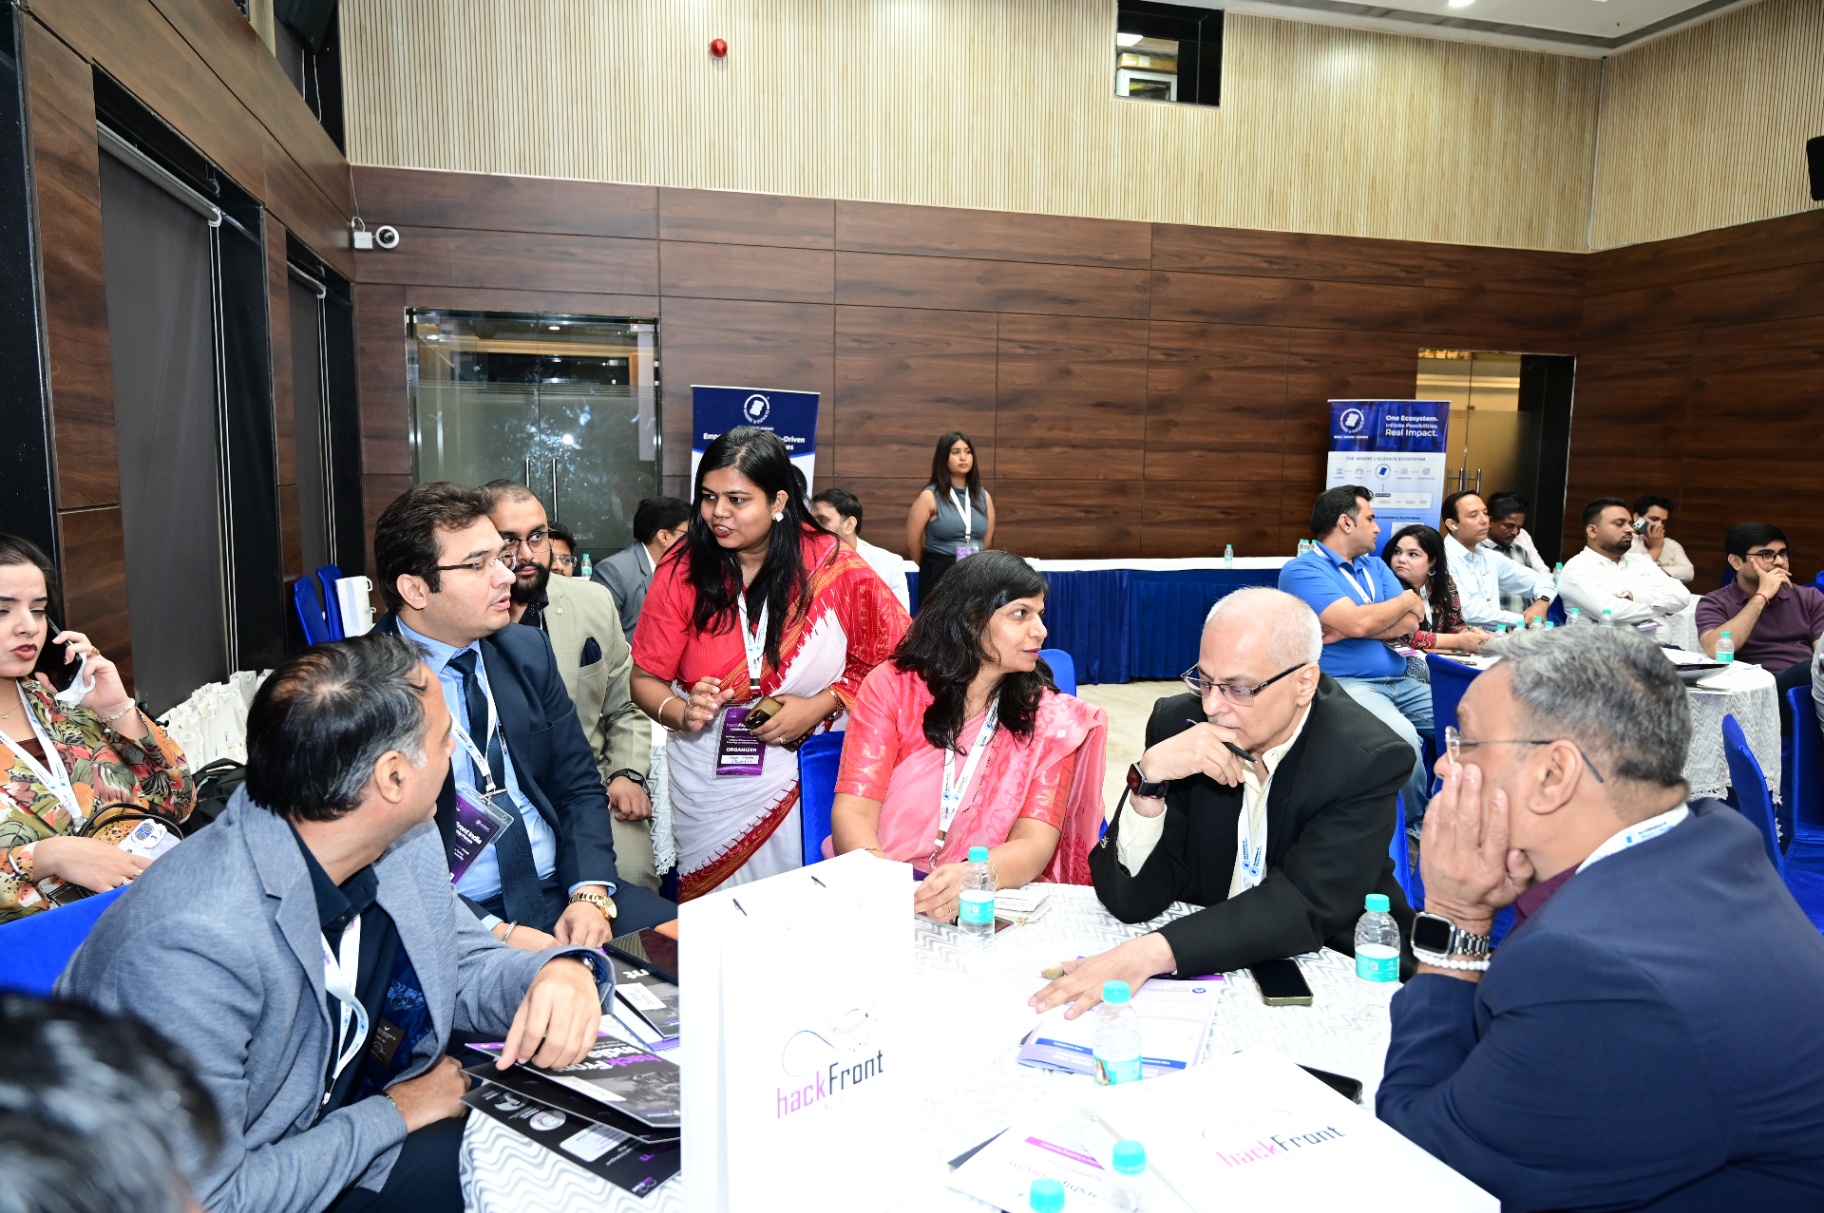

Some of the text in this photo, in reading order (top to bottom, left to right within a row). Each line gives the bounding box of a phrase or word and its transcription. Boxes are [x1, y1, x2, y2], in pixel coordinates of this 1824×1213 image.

[1400, 415, 1439, 423] Ecosystem.
[1385, 429, 1439, 438] Real Impact.
[467, 831, 483, 845] India
[587, 1045, 644, 1058] India
[776, 1049, 884, 1119] hackFront
[1215, 1125, 1347, 1168] hackFront
